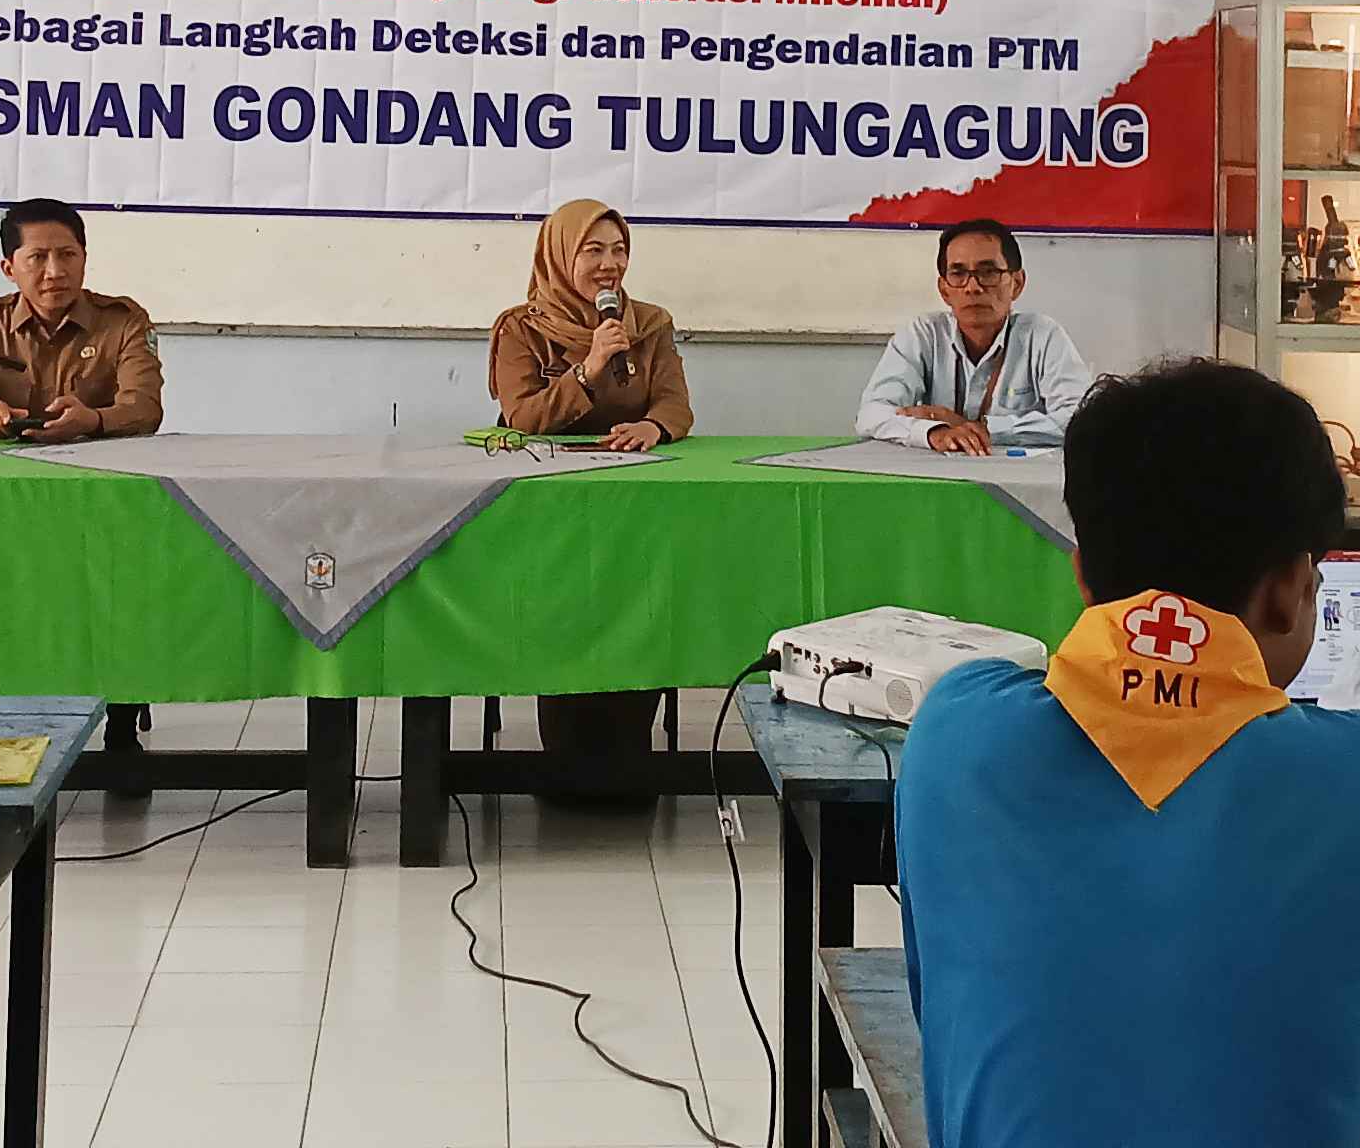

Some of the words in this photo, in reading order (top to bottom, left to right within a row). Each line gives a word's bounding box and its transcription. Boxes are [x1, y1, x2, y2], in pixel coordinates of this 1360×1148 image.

[160, 14, 356, 56] Langkah
[373, 20, 547, 56] Deteksi
[562, 26, 644, 59] dan
[661, 28, 972, 70] Pengendalian
[989, 37, 1078, 71] PTM
[213, 85, 571, 149] GONDANG
[598, 95, 1144, 163] TULUNGAGUNG
[1121, 668, 1200, 709] PMI
